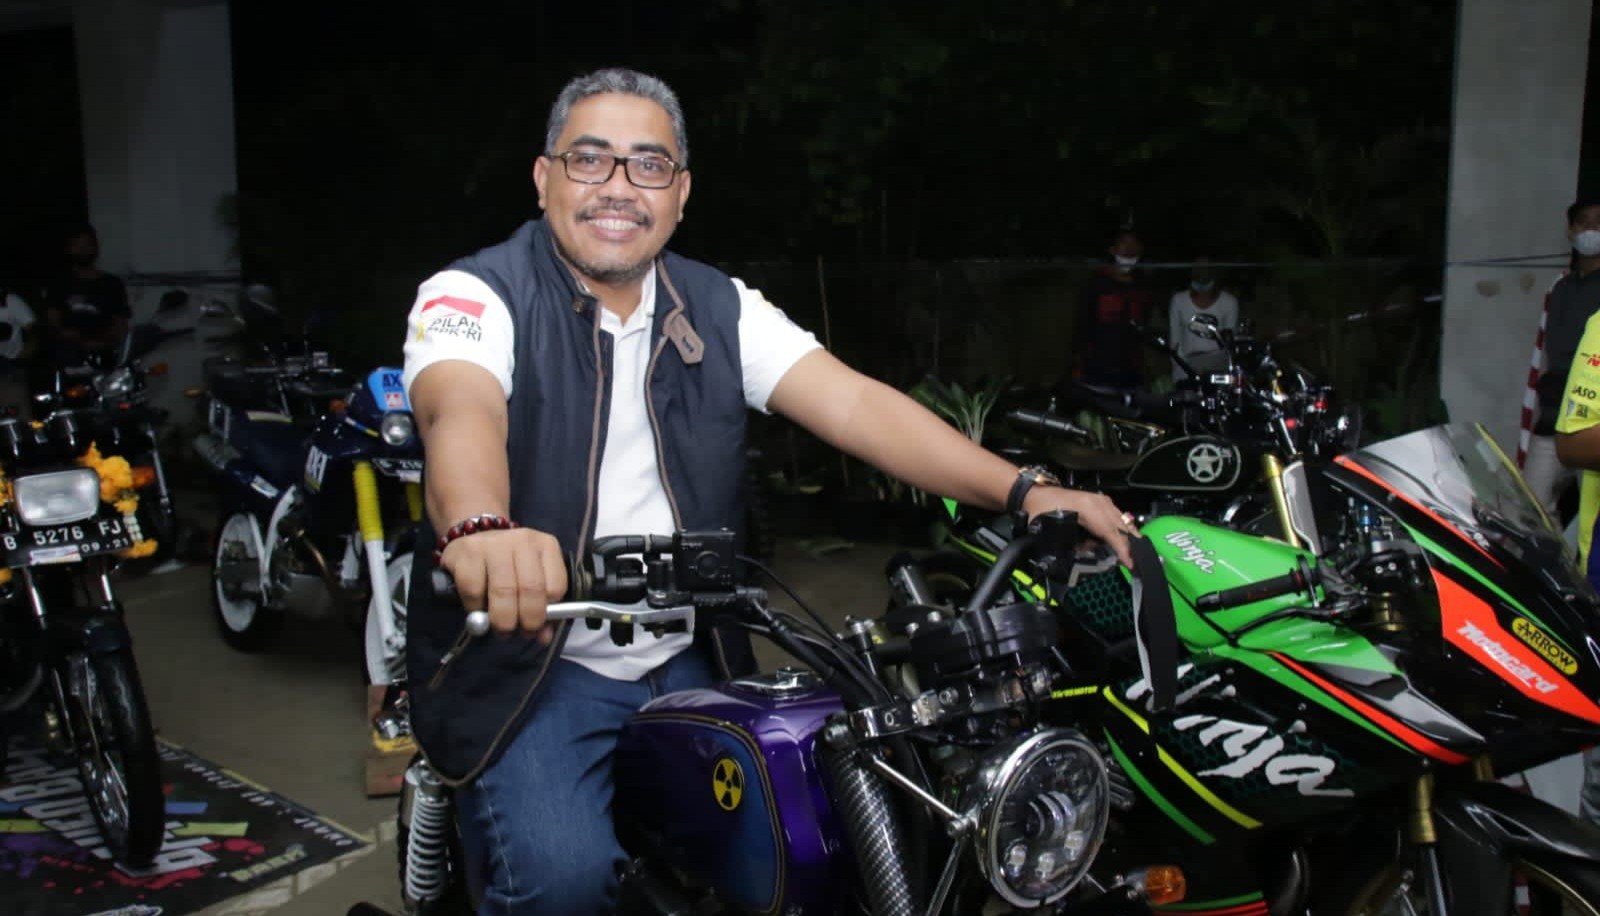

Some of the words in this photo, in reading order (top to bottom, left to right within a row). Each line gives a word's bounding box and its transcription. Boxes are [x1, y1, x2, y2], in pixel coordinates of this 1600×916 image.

[3, 535, 17, 551] B
[33, 525, 84, 546] 5276
[98, 519, 121, 536] FJ
[1165, 530, 1216, 575] Ninja
[1456, 619, 1560, 694] Motocard
[1517, 619, 1575, 668] ARROW
[1125, 662, 1356, 797] Ninja
